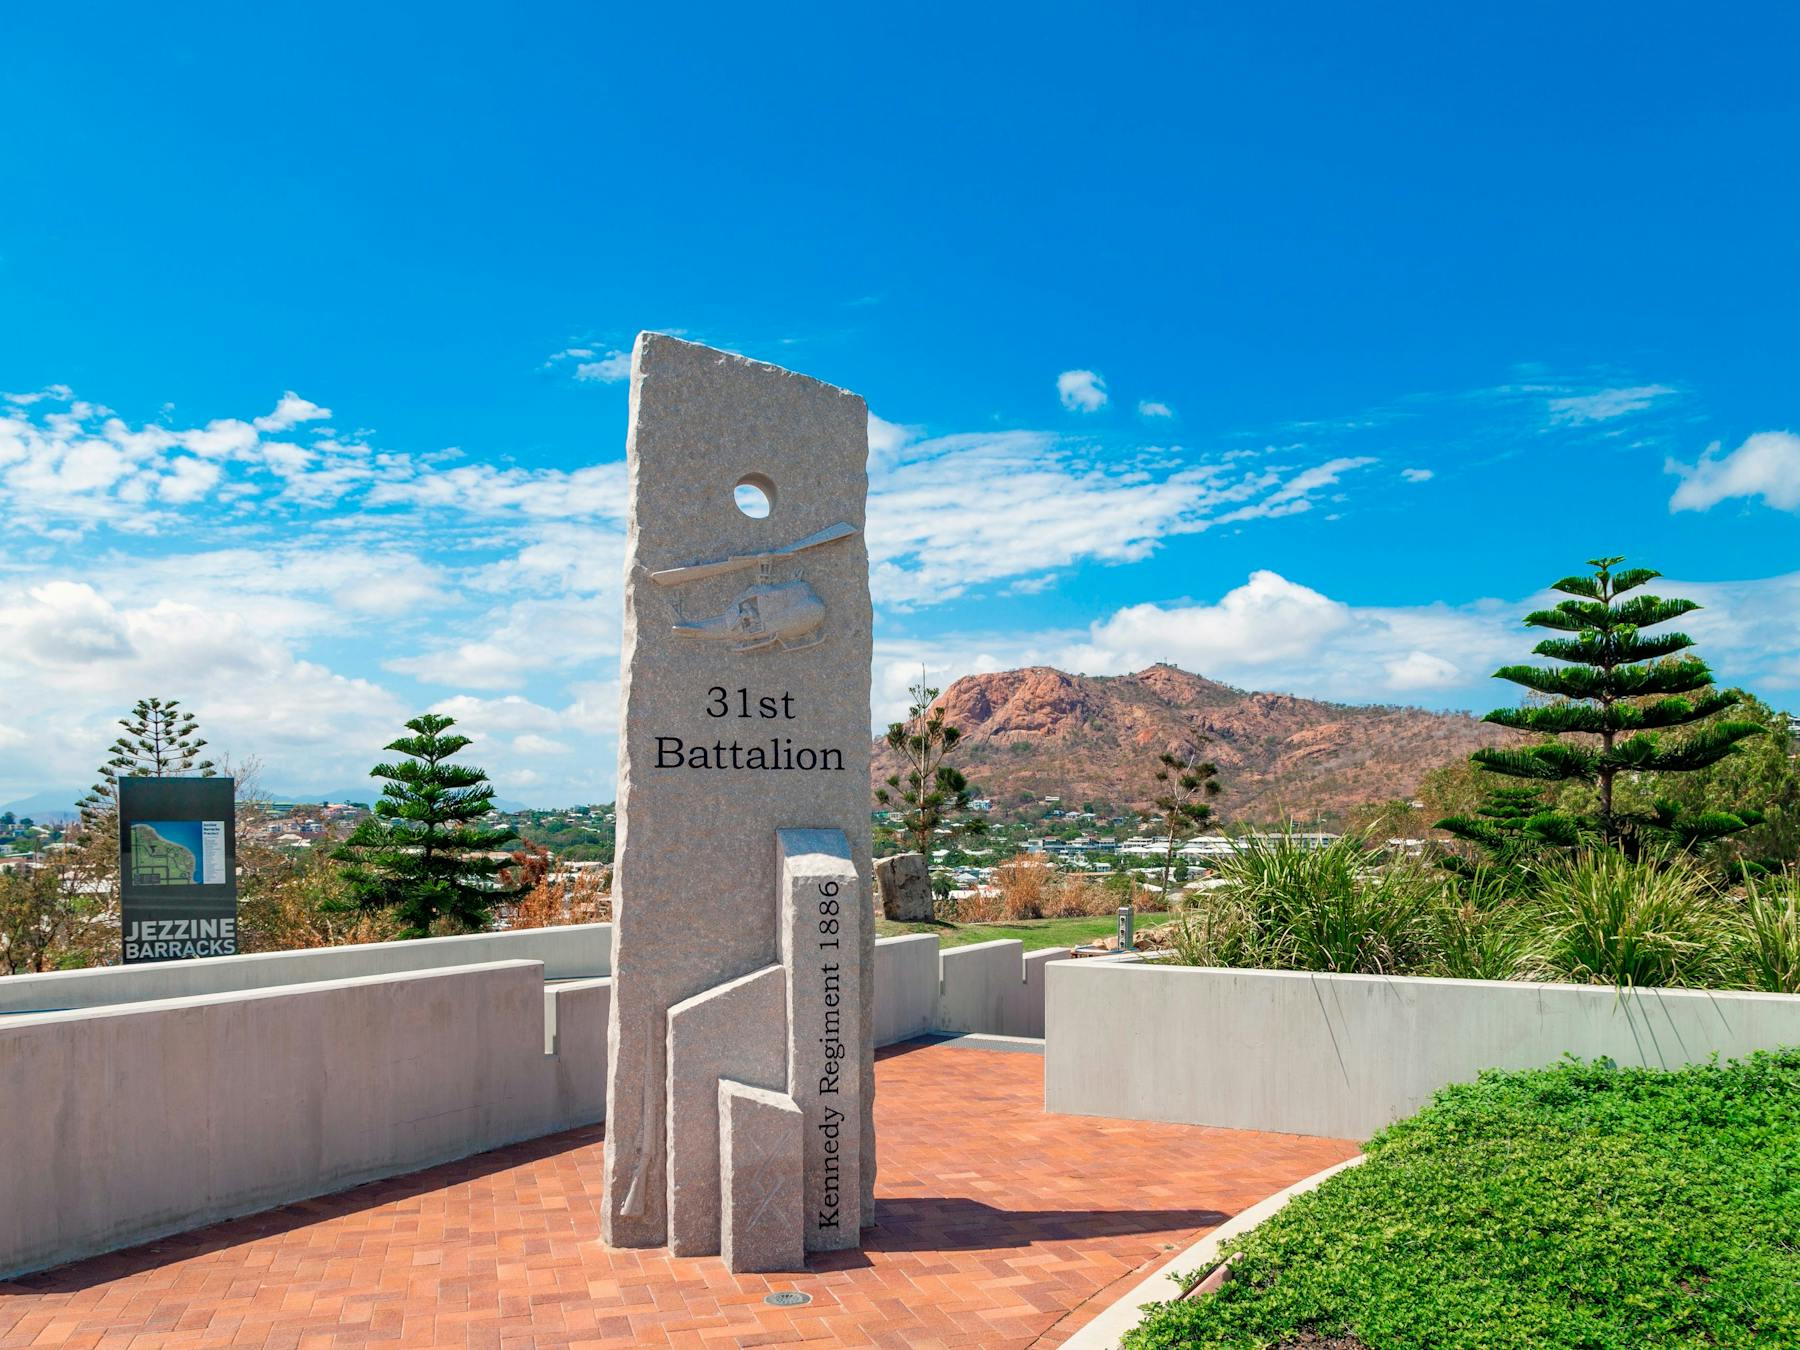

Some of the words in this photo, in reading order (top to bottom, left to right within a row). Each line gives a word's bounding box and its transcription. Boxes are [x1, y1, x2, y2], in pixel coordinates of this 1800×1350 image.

[706, 686, 796, 719] 31st
[654, 736, 846, 770] Battalion
[124, 918, 235, 942] JEZZINE
[819, 881, 839, 950] 1886
[125, 939, 236, 959] BARRACKS
[819, 963, 845, 1096] Regiment
[819, 1105, 845, 1230] Kennedy
